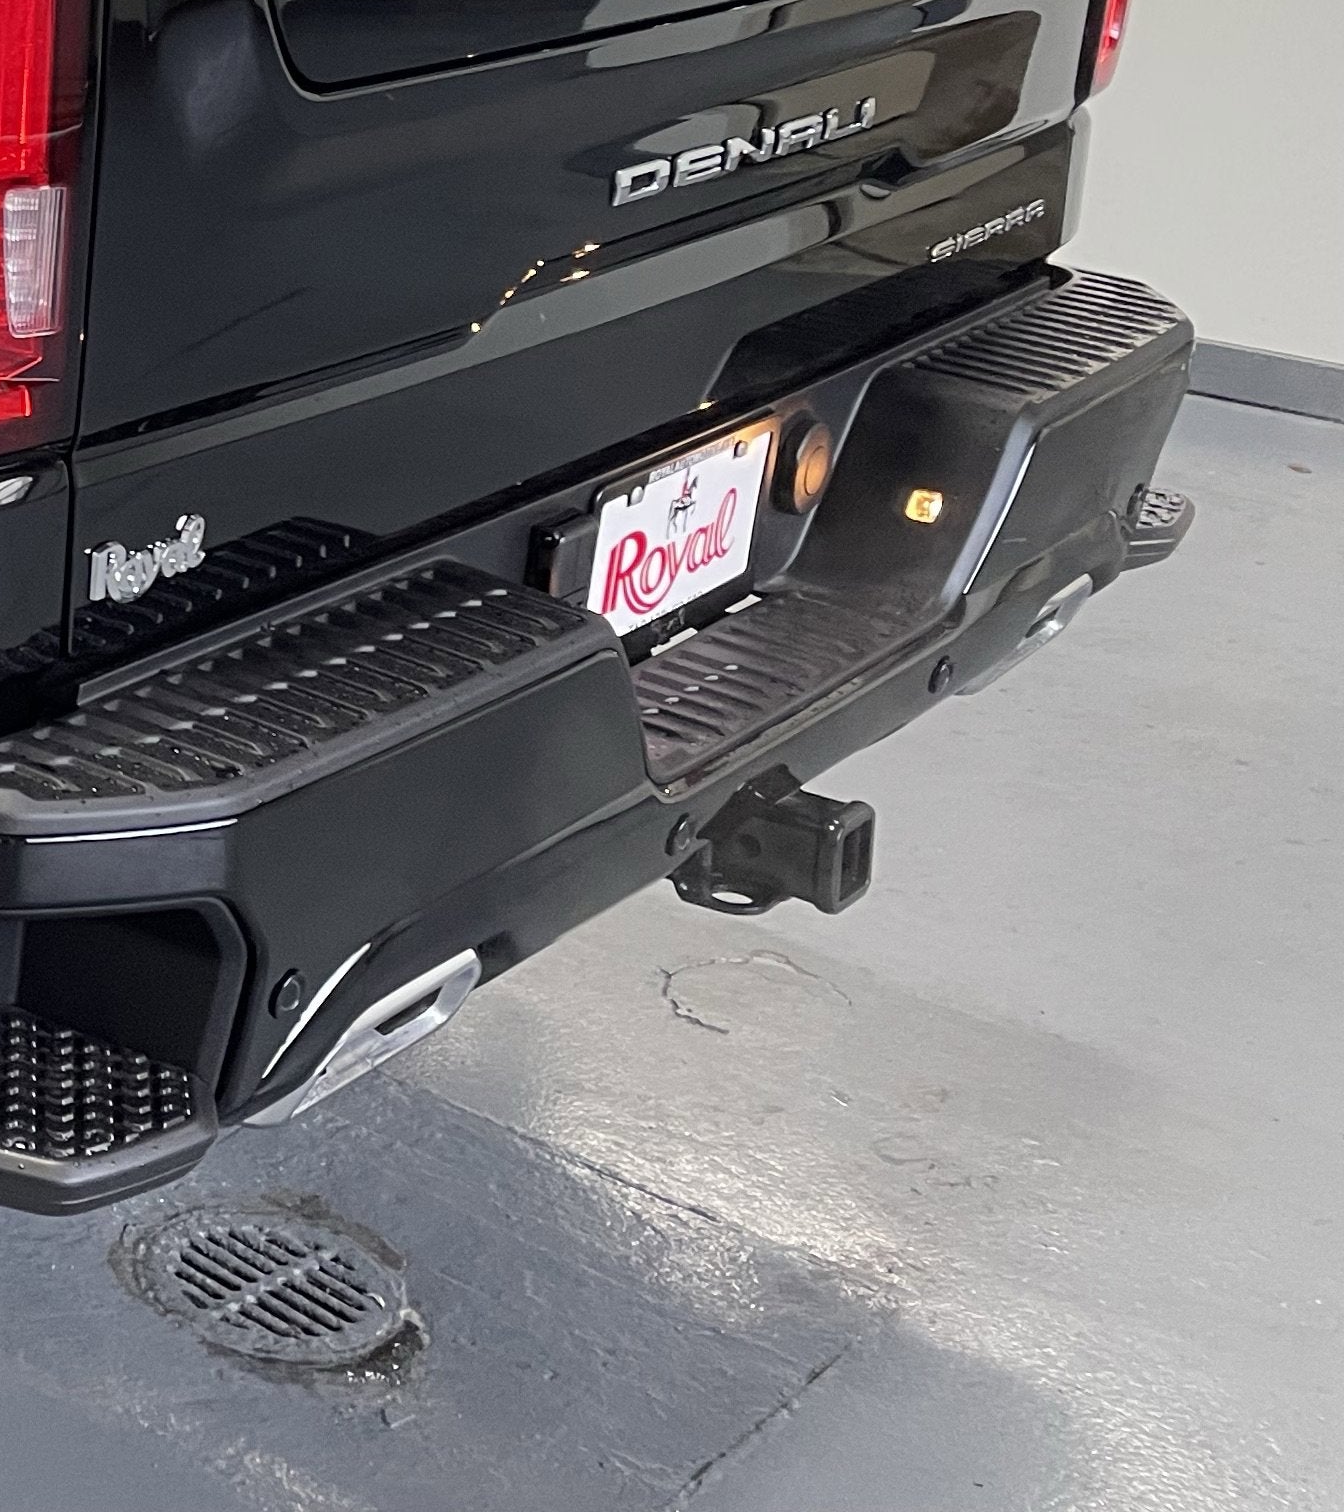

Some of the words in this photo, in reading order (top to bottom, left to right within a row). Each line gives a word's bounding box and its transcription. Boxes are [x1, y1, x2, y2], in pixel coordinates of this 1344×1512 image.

[614, 97, 876, 206] DENALI
[929, 199, 1046, 263] SIERRA
[89, 514, 205, 603] Royal
[602, 487, 736, 616] Royal
